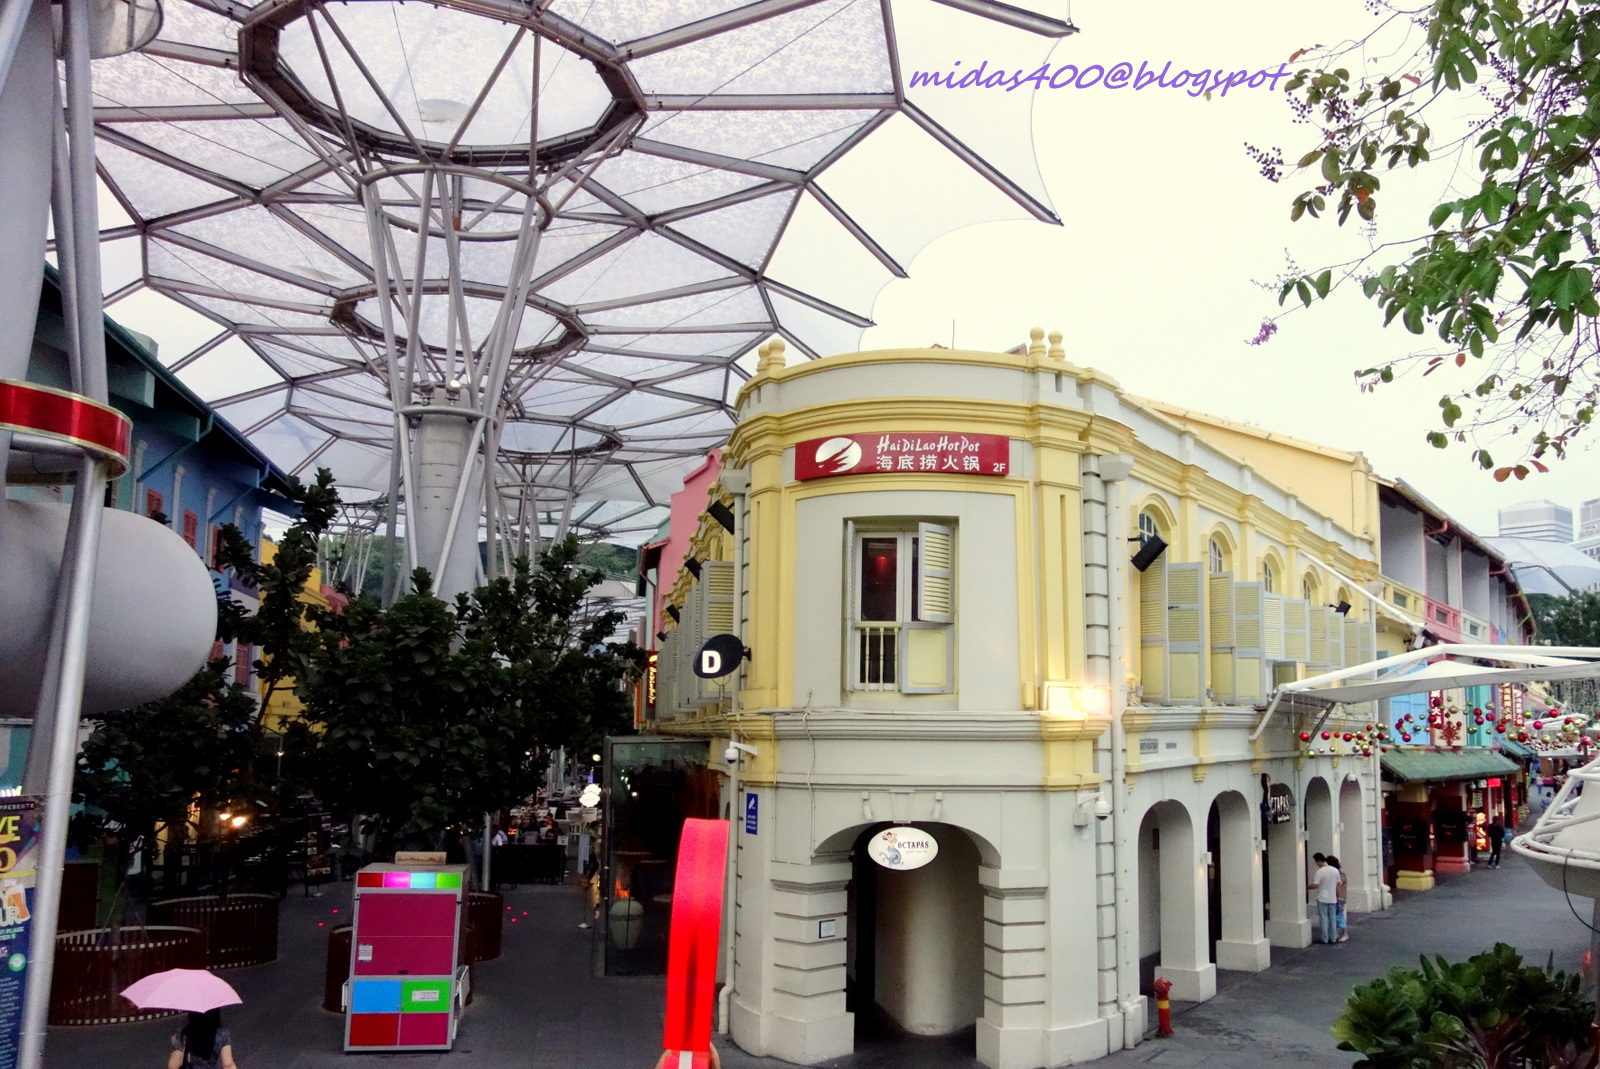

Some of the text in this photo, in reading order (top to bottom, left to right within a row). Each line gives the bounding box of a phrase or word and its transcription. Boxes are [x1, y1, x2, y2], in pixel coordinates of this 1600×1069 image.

[876, 454, 981, 471] 海底捞火锅
[993, 462, 1006, 473] 2F
[702, 650, 721, 674] D
[897, 840, 930, 849] OCTAPAS
